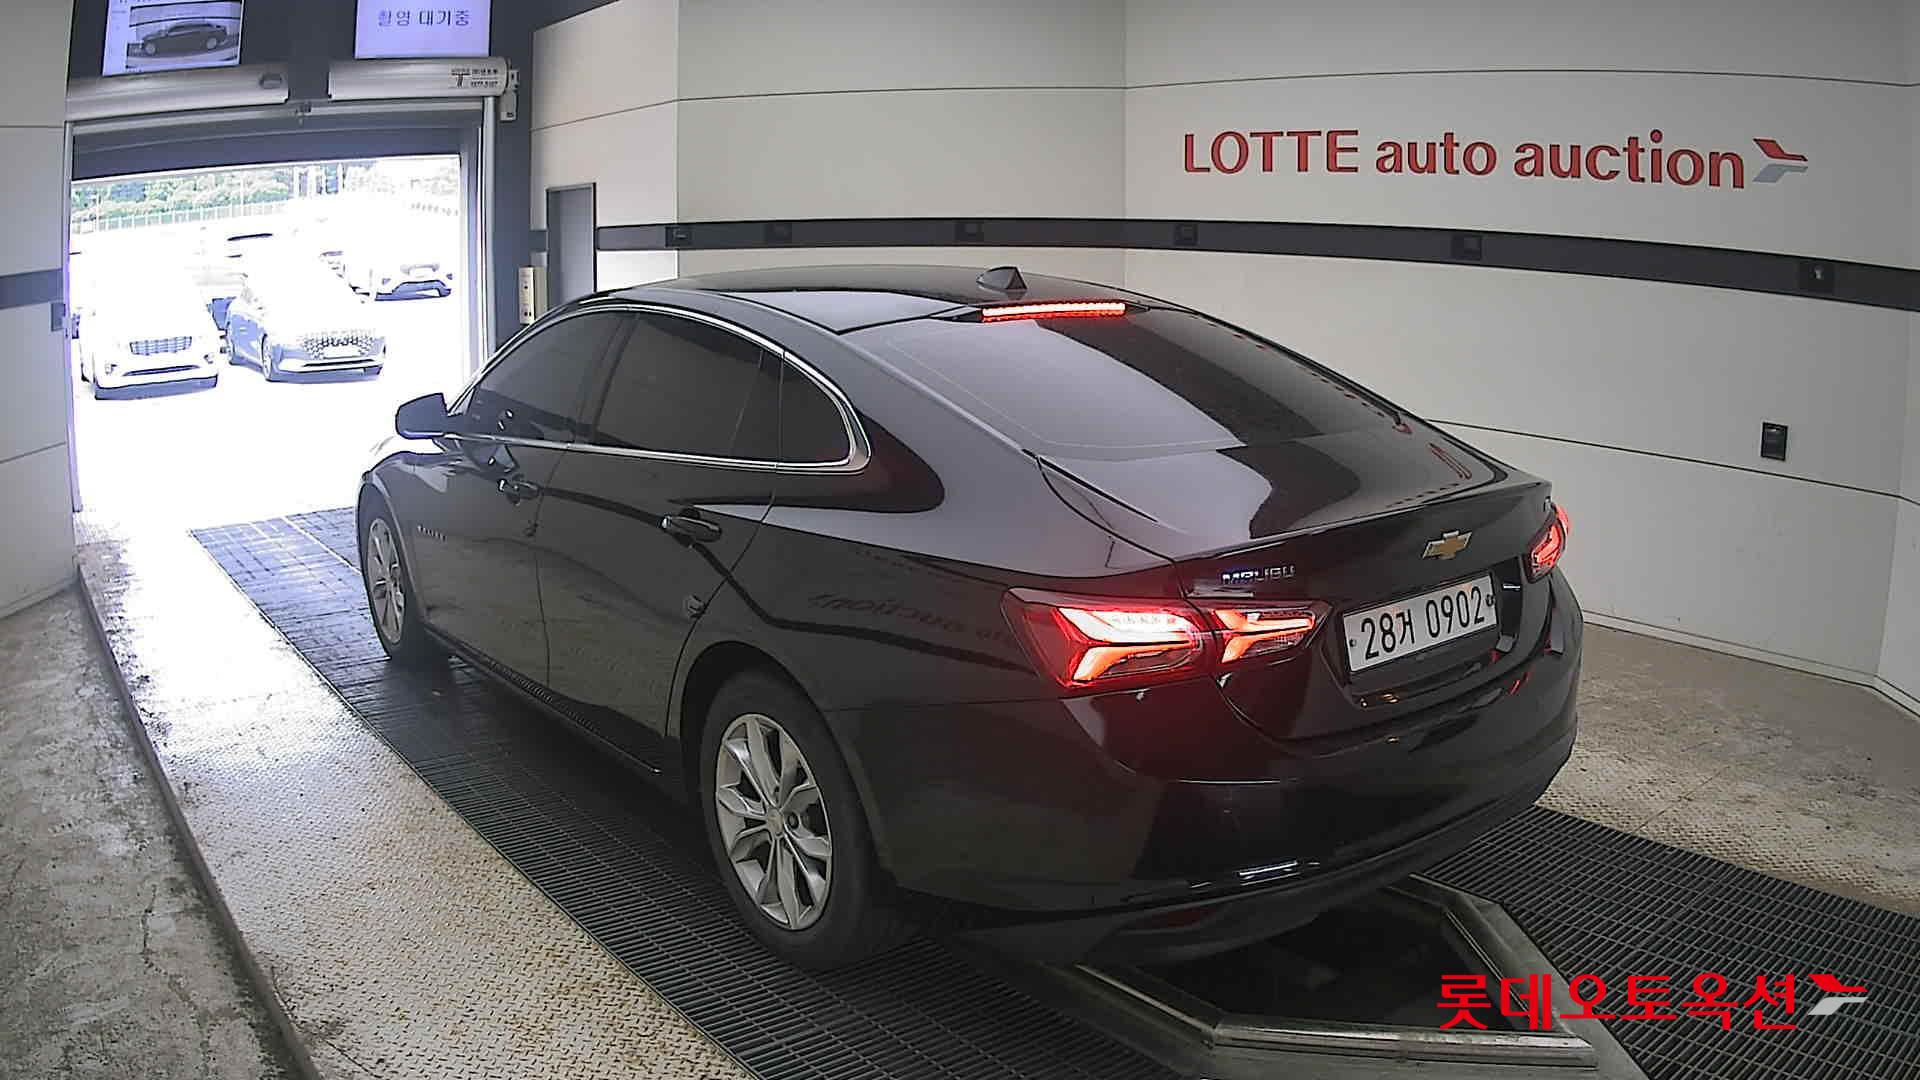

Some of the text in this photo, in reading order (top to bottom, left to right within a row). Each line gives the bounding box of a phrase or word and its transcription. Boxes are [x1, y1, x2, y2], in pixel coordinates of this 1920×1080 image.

[419, 9, 470, 27] 대기중
[1184, 128, 1746, 190] LOTTE auto auction
[1361, 586, 1486, 661] 28거 0902
